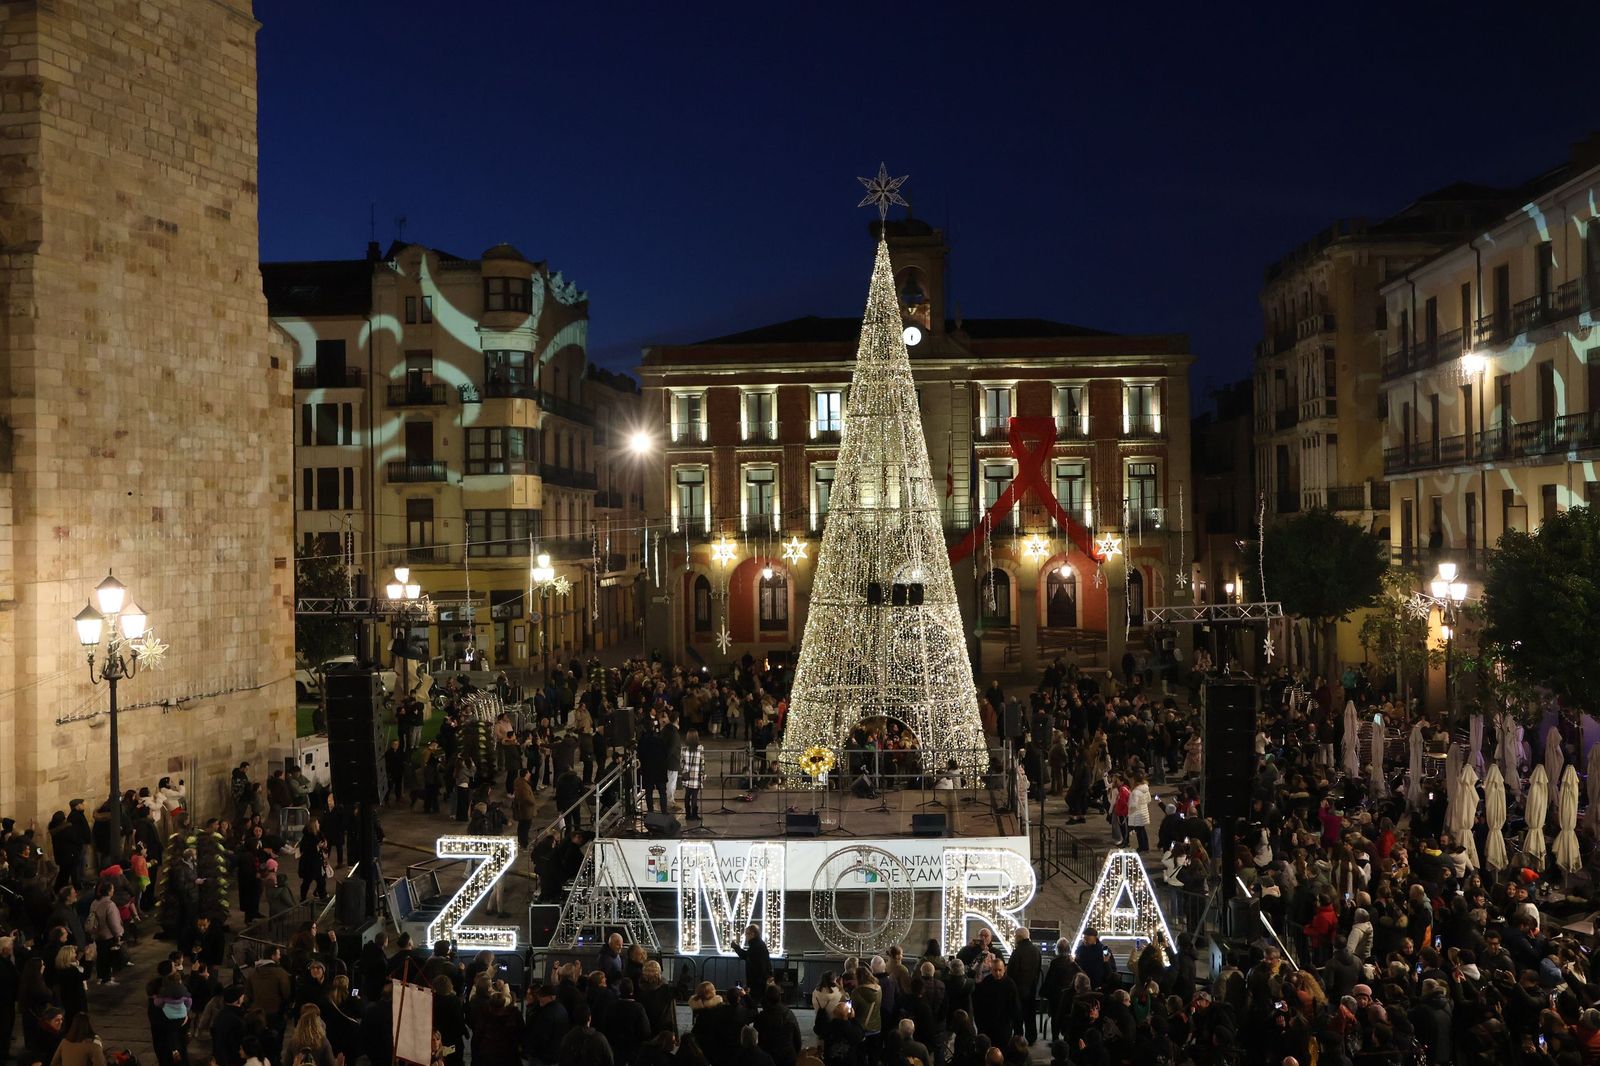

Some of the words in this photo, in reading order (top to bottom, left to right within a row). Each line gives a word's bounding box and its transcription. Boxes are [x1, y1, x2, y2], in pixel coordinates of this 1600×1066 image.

[671, 856, 770, 868] AUTMIENTO
[879, 855, 980, 867] AYUNTAMENO
[697, 869, 769, 883] AMOR
[880, 868, 900, 882] DE
[426, 835, 1178, 957] ZAMORA
